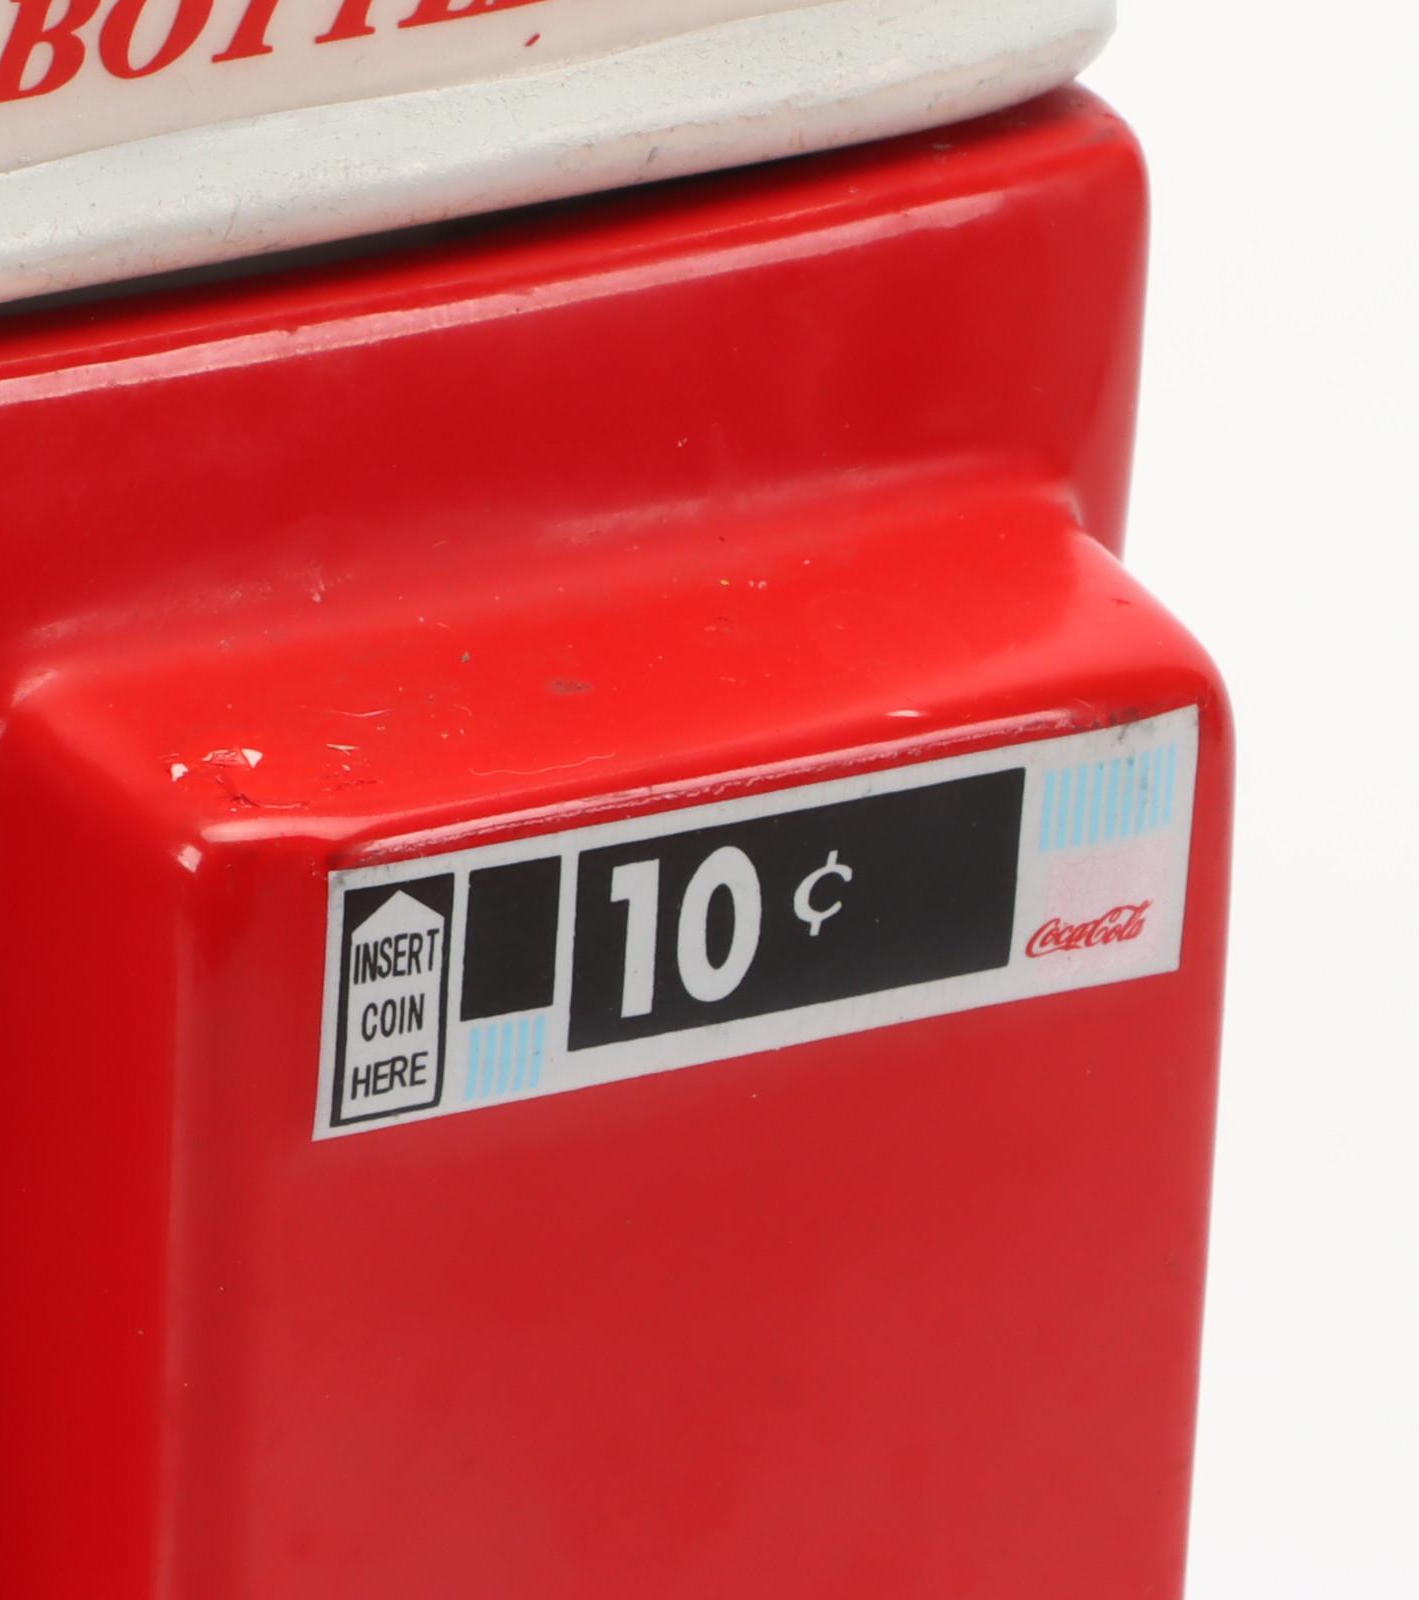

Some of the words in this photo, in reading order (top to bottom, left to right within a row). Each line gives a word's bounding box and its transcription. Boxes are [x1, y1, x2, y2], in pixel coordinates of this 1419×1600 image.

[353, 928, 441, 985] INSERT
[361, 992, 426, 1043] COIN
[350, 1051, 429, 1101] HERE
